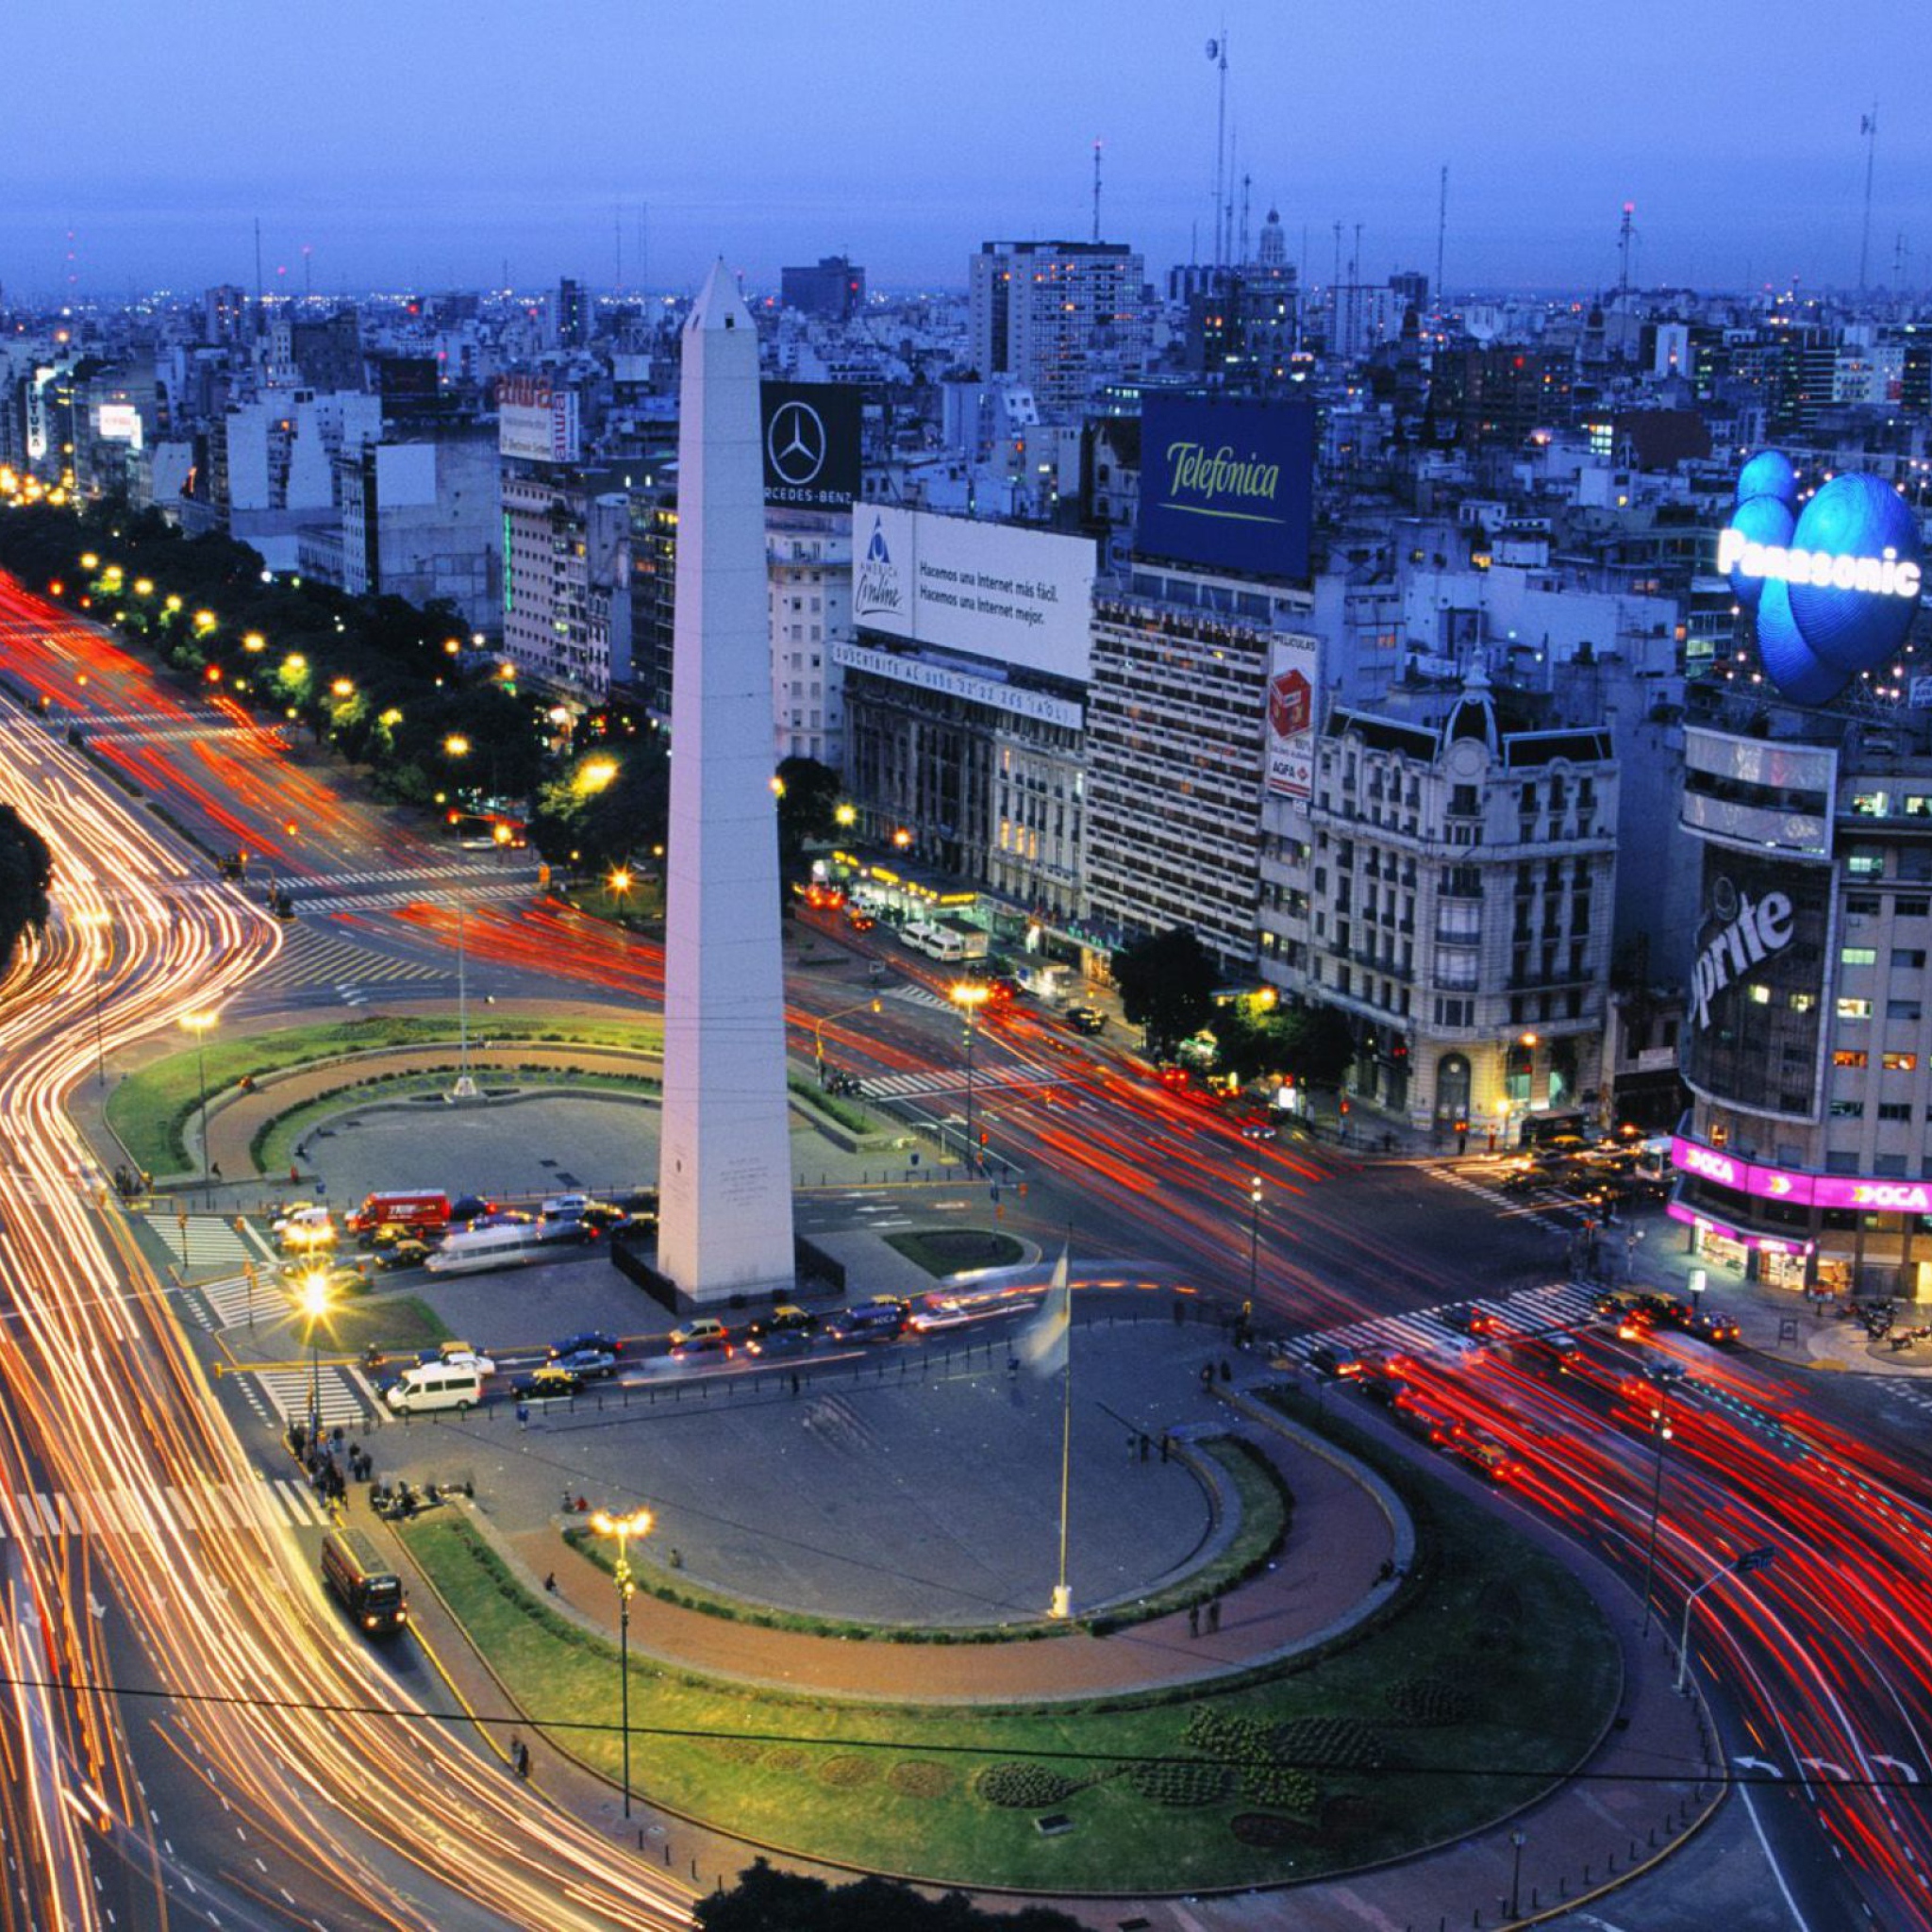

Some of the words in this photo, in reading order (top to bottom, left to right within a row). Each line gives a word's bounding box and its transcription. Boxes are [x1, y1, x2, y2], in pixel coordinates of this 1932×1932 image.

[495, 374, 554, 408] aiwa
[763, 486, 853, 506] RCEDES-BENZ
[919, 561, 958, 583] Hacemos
[958, 572, 975, 586] una
[976, 572, 1013, 594] Internet
[1717, 528, 1922, 597] Panasonic
[919, 585, 958, 607] Hacemos
[958, 595, 975, 610] una
[976, 597, 1013, 619] Internet
[1015, 608, 1044, 628] mejor.
[1273, 760, 1295, 778] AGFA
